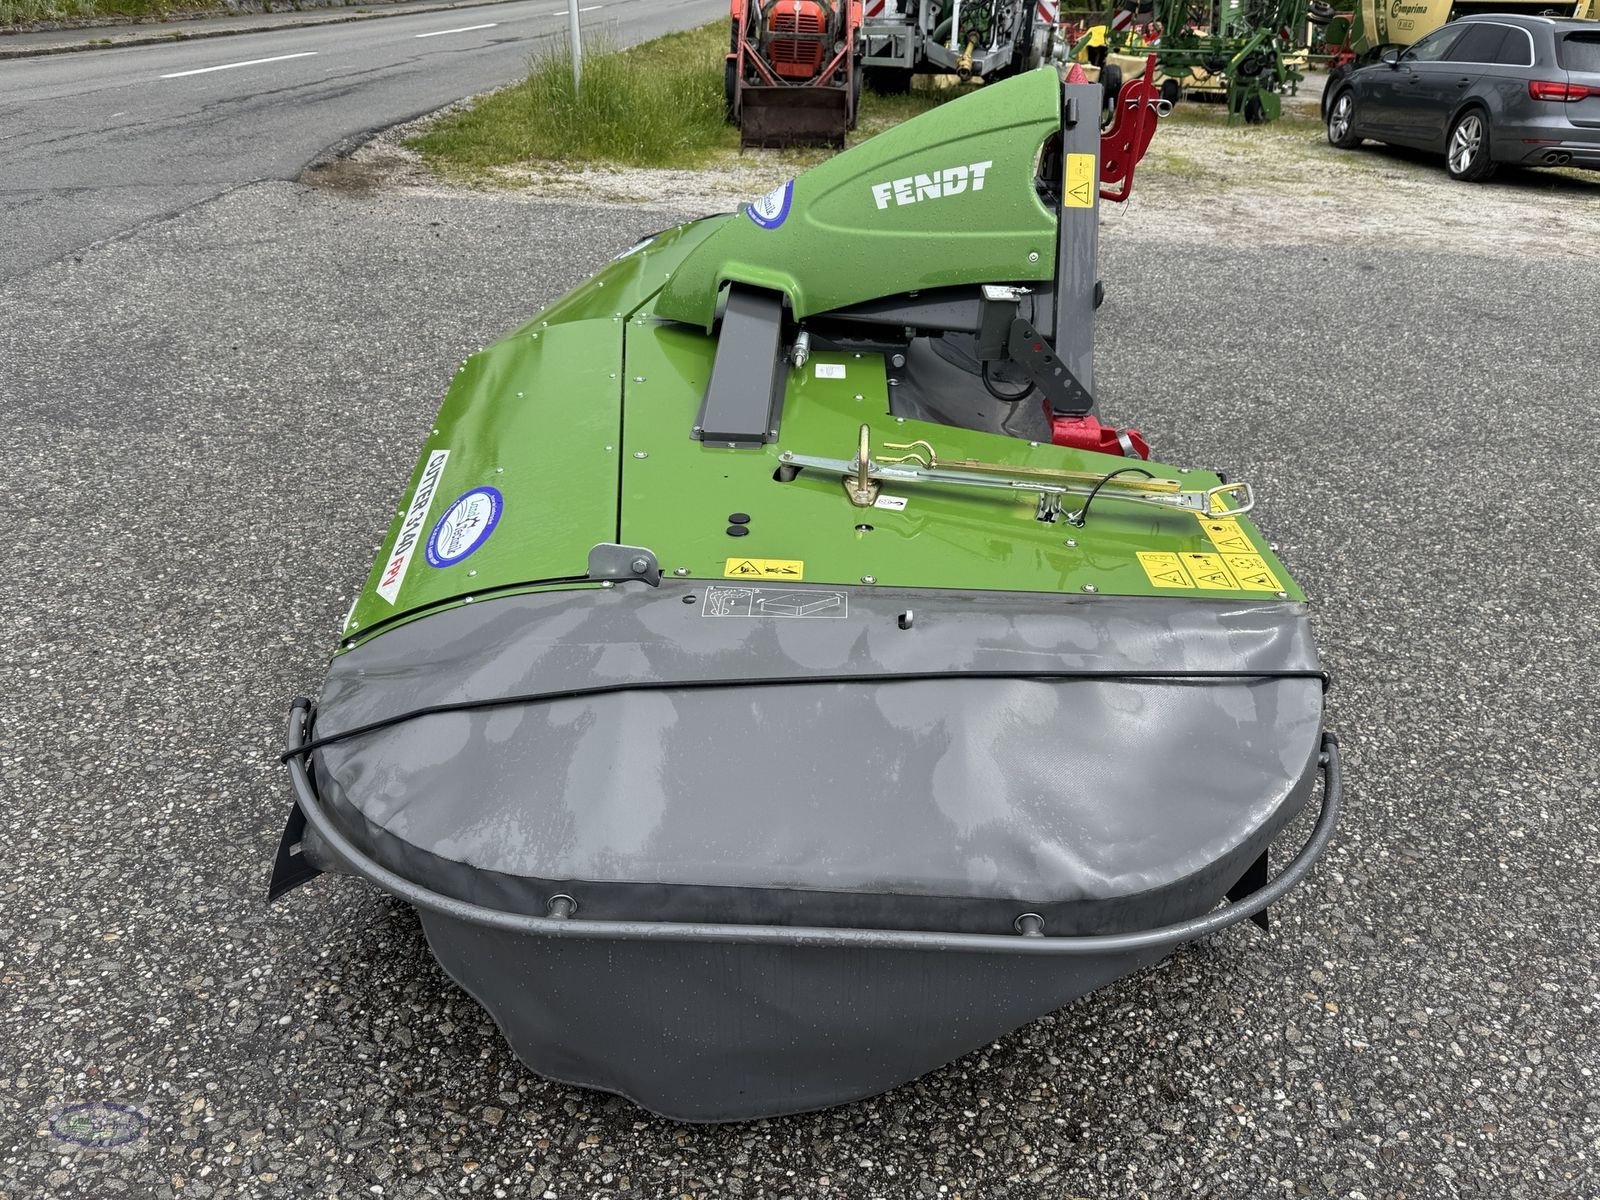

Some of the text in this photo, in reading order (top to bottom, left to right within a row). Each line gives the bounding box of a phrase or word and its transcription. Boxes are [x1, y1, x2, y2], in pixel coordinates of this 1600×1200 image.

[1391, 0, 1428, 18] Comprima
[871, 160, 993, 210] FENDT
[411, 454, 446, 515] CUTTER
[394, 511, 424, 556] 3140
[382, 556, 405, 587] FPV
